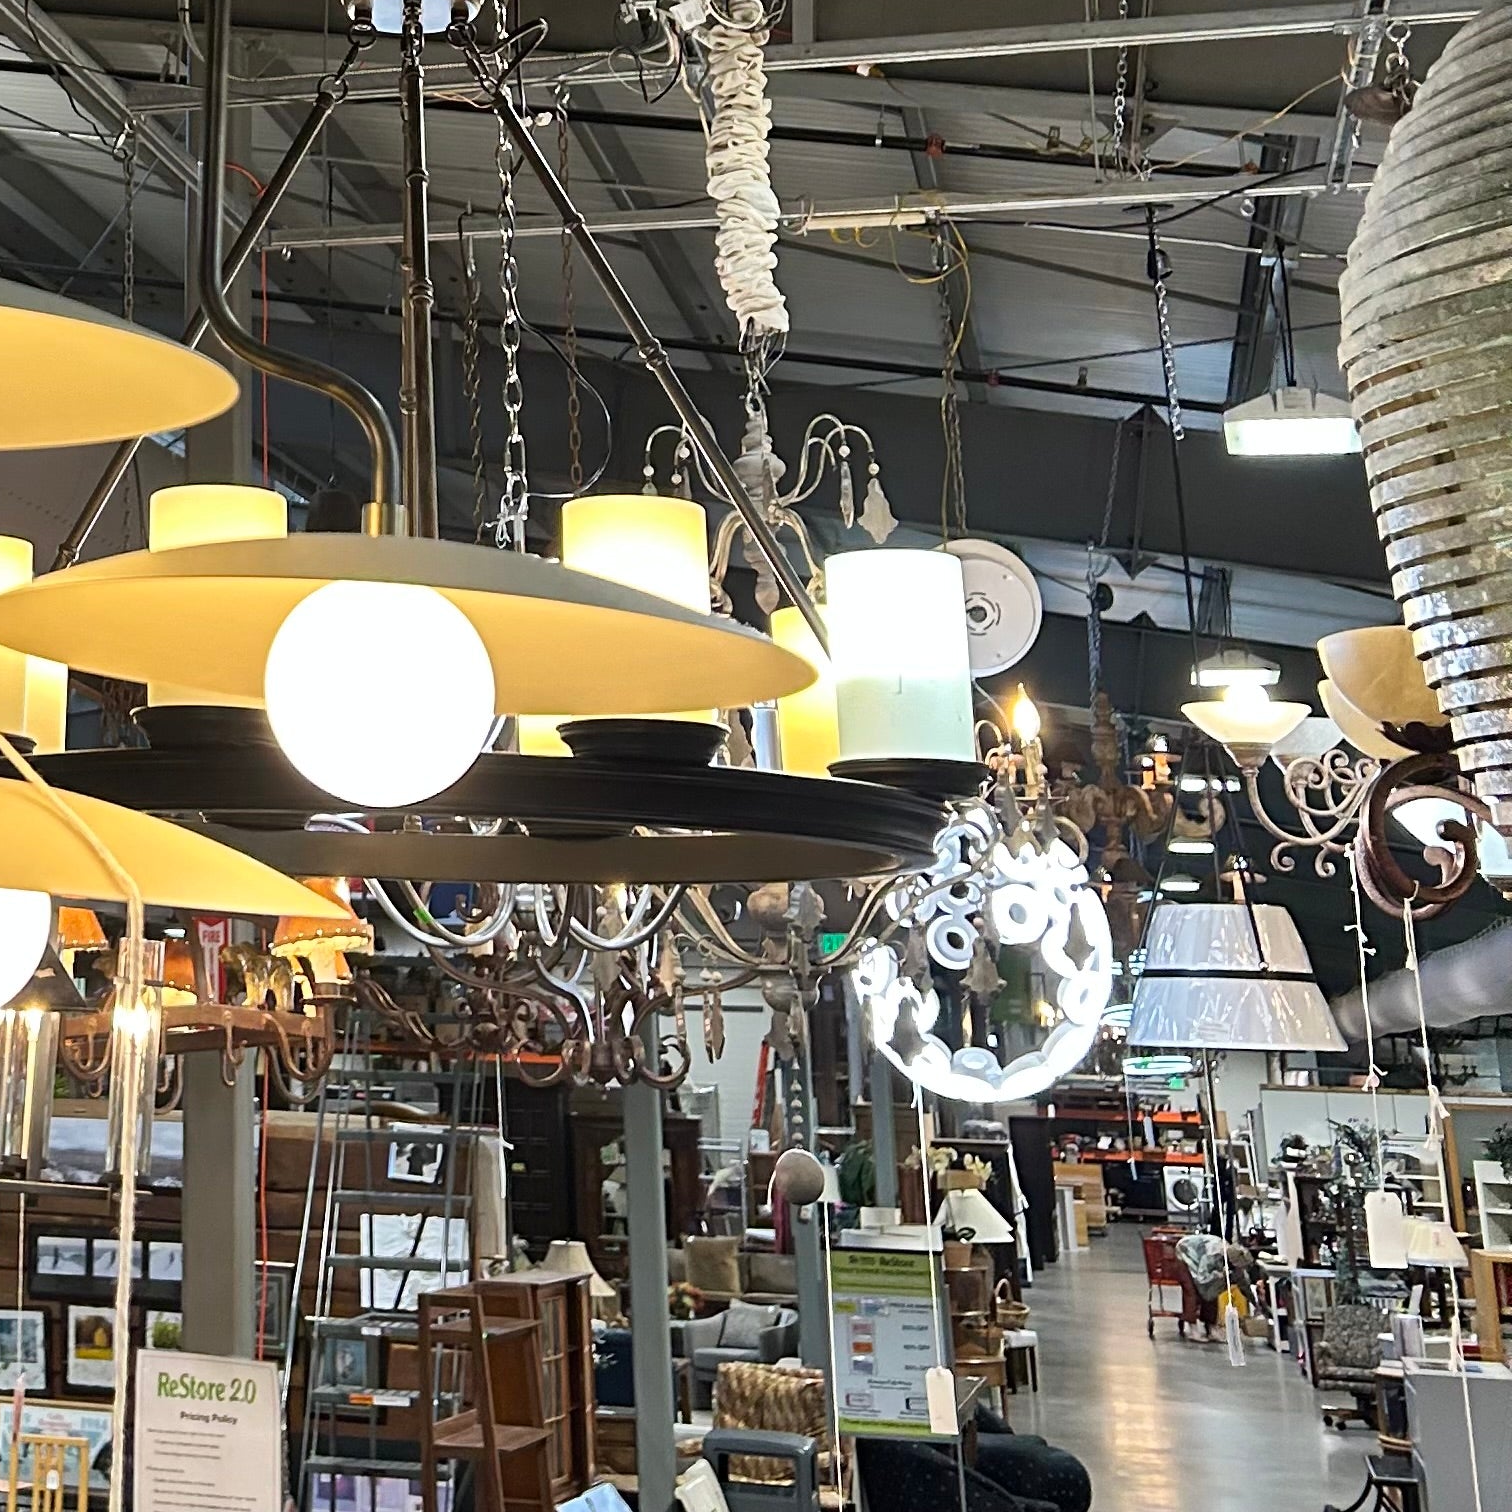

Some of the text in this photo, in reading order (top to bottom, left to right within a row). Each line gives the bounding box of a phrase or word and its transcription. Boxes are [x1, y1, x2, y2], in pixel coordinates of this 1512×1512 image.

[157, 1372, 257, 1404] ReStore 2.0
[180, 1411, 238, 1425] Pricing Policy
